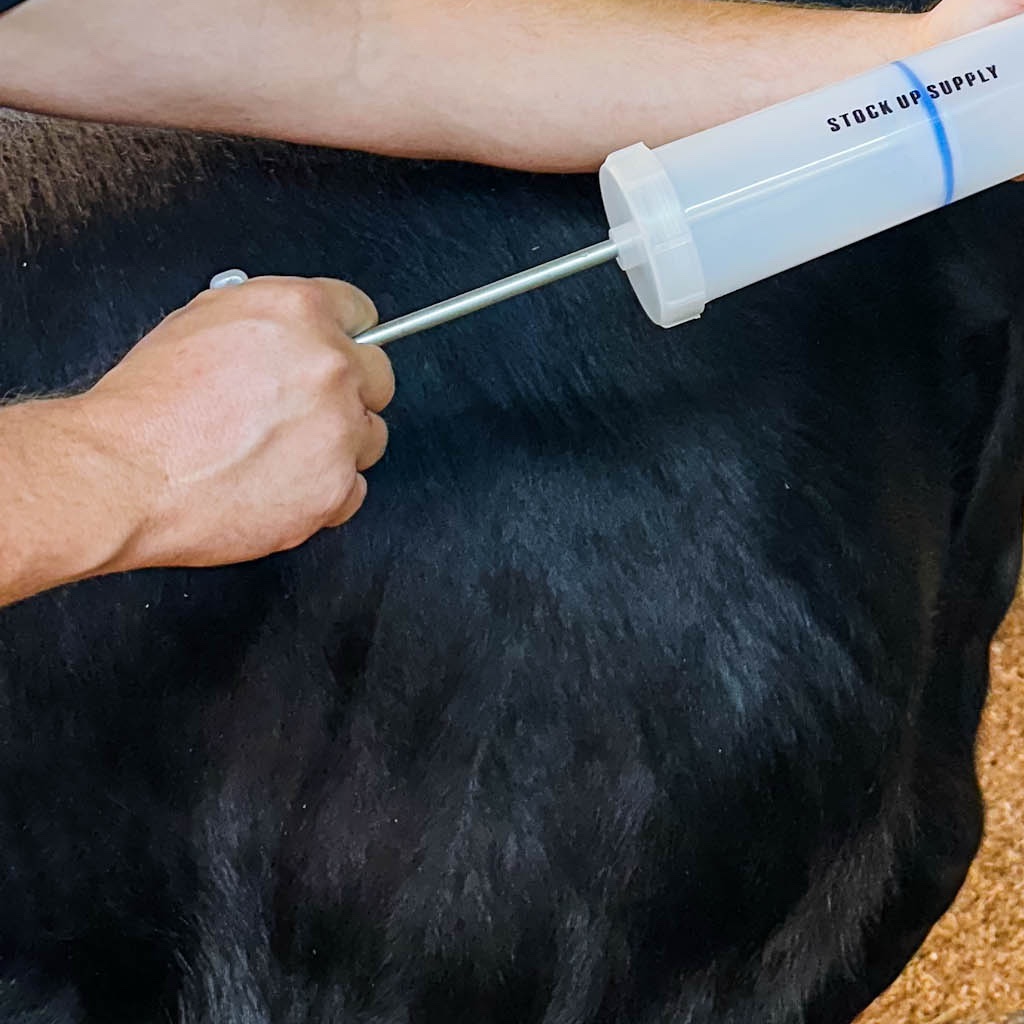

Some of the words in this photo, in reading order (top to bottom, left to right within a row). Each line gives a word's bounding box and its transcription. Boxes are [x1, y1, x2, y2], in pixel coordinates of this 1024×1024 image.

[827, 100, 893, 132] STOCK
[896, 89, 922, 109] UP
[926, 64, 999, 99] SUPPLY
